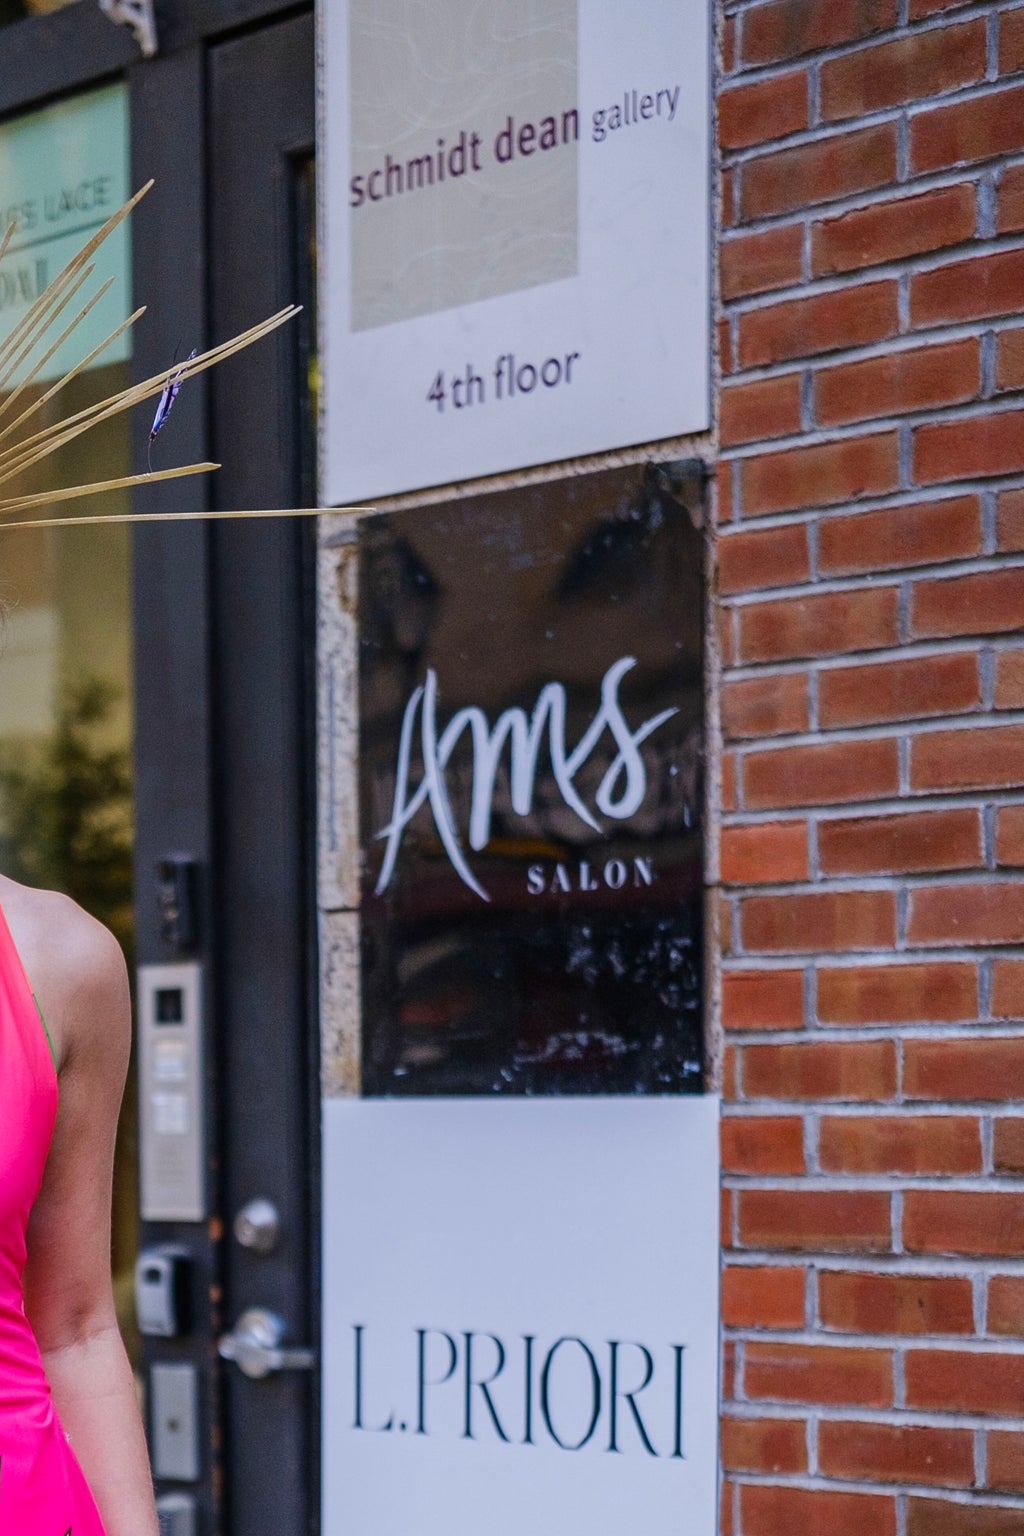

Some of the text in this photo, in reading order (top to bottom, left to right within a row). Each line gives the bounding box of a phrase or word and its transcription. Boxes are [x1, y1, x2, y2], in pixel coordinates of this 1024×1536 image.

[349, 86, 680, 207] schmidt dean gallery
[43, 175, 113, 223] LACE
[426, 351, 580, 412] 4th floor
[375, 656, 680, 902] Ams
[526, 856, 656, 895] SALON
[351, 1324, 688, 1460] L.PRIORI
